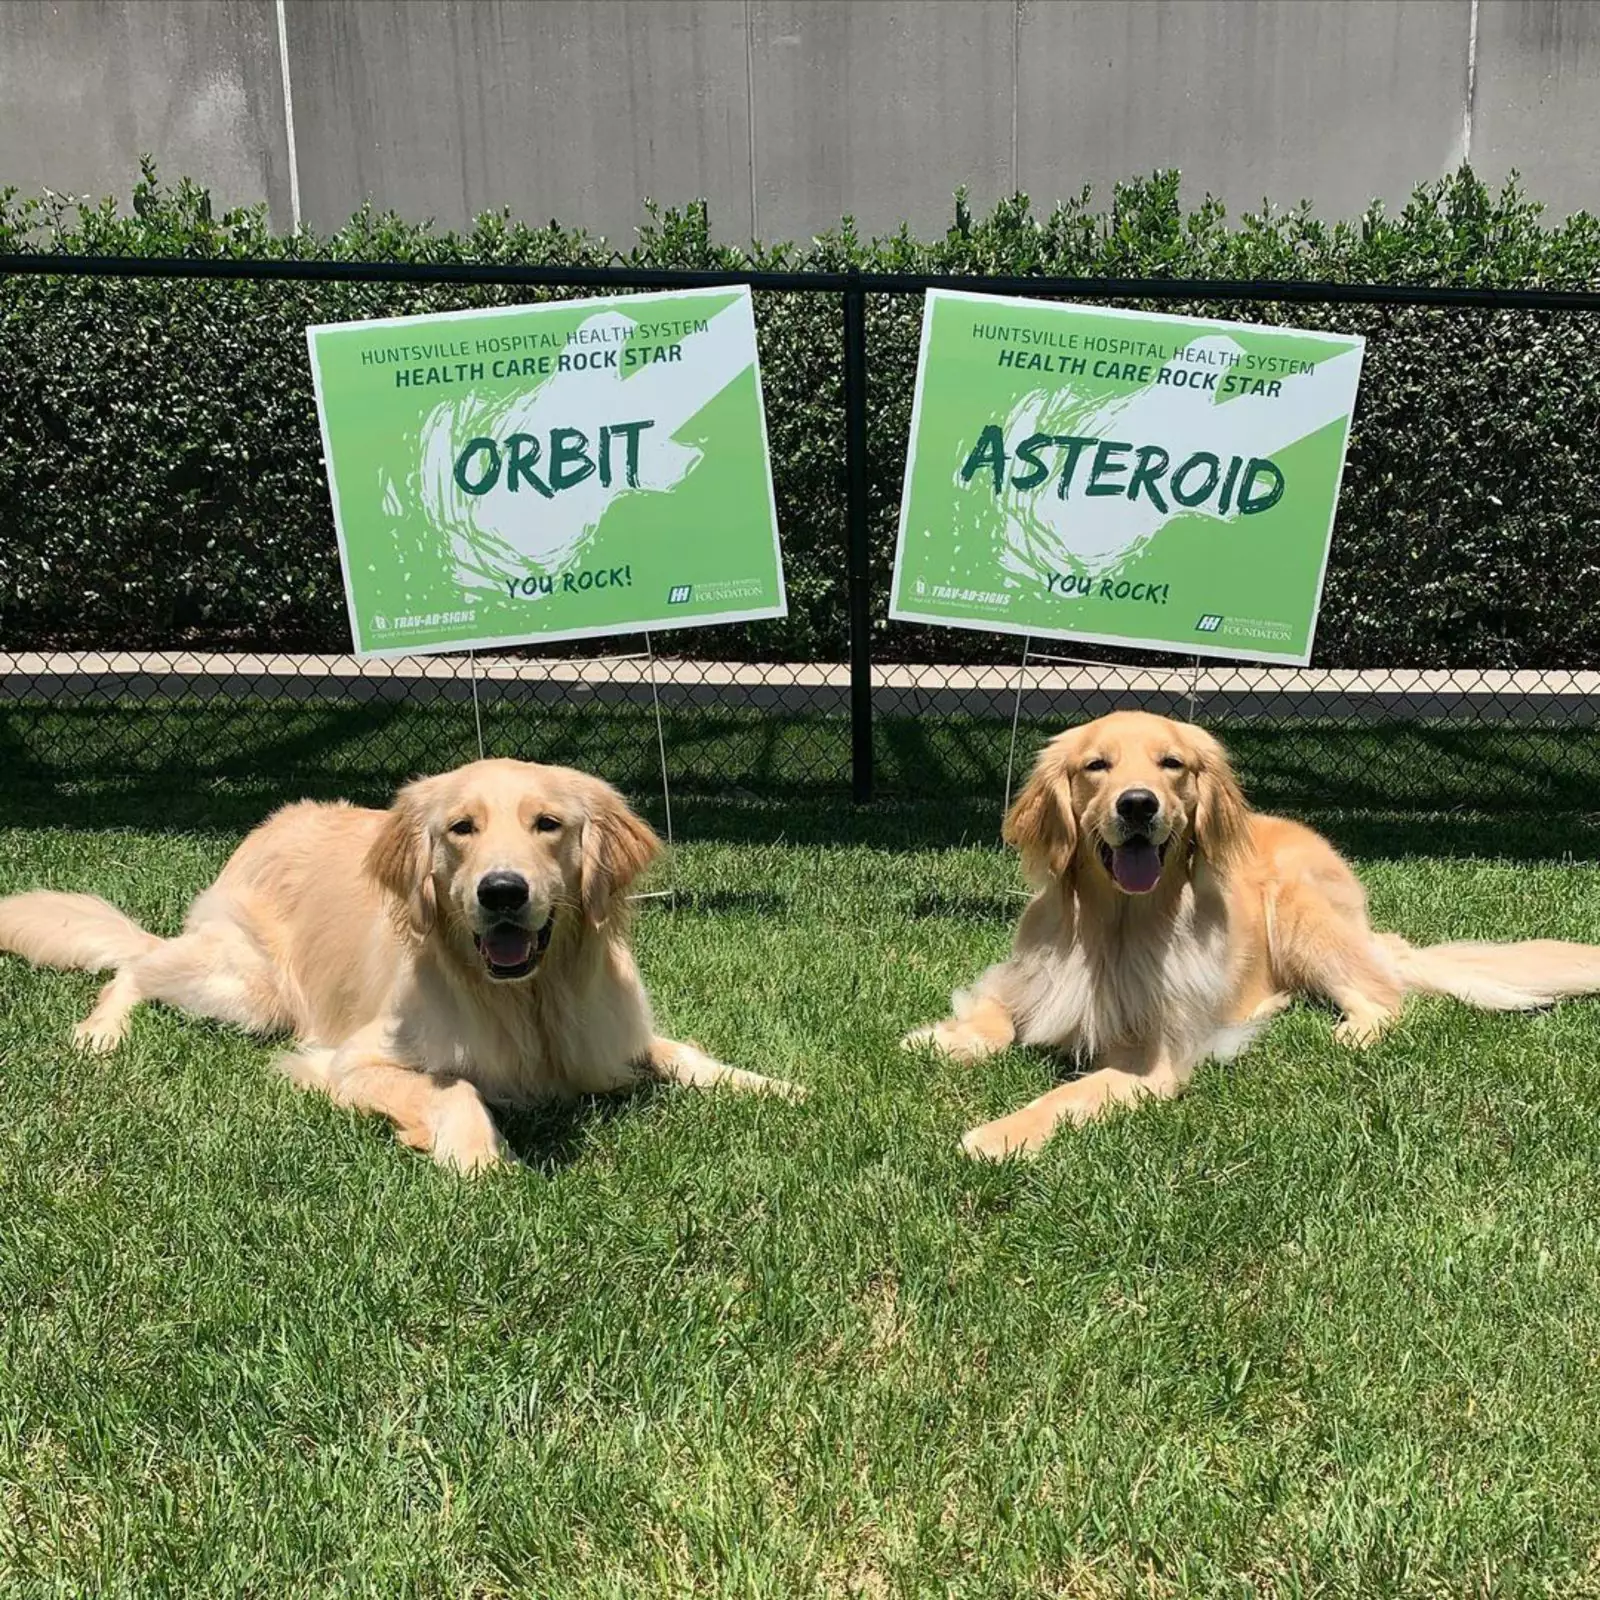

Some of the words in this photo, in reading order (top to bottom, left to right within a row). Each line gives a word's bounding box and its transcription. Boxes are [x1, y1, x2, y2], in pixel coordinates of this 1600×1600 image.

[361, 340, 470, 365] HUNTSVILLE
[476, 332, 561, 355] HOSPITAL
[567, 326, 634, 345] HEALTH
[639, 319, 709, 340] SYSTEM
[973, 323, 1078, 349] HUNTSVILLE
[1083, 336, 1167, 360] HOSPITAL
[1173, 346, 1240, 367] HEALTH
[1246, 355, 1315, 376] SYSTEM
[396, 361, 485, 387] HEALTH
[492, 355, 550, 378] CARE
[558, 349, 617, 372] ROCK
[624, 344, 682, 366] STAR
[998, 349, 1087, 376] HEALTH
[1093, 360, 1152, 383] CARE
[1157, 367, 1218, 390] ROCK
[1223, 374, 1282, 398] STAR
[453, 420, 655, 499] ORBIT
[959, 425, 1285, 516] ASTEROID
[506, 575, 553, 599] YOU
[562, 565, 632, 594] ROCK!
[695, 587, 762, 602] FOUNDATION
[1047, 573, 1091, 596] YOU
[1099, 579, 1169, 604] ROCK!
[1223, 625, 1292, 640] FOUNDATION
